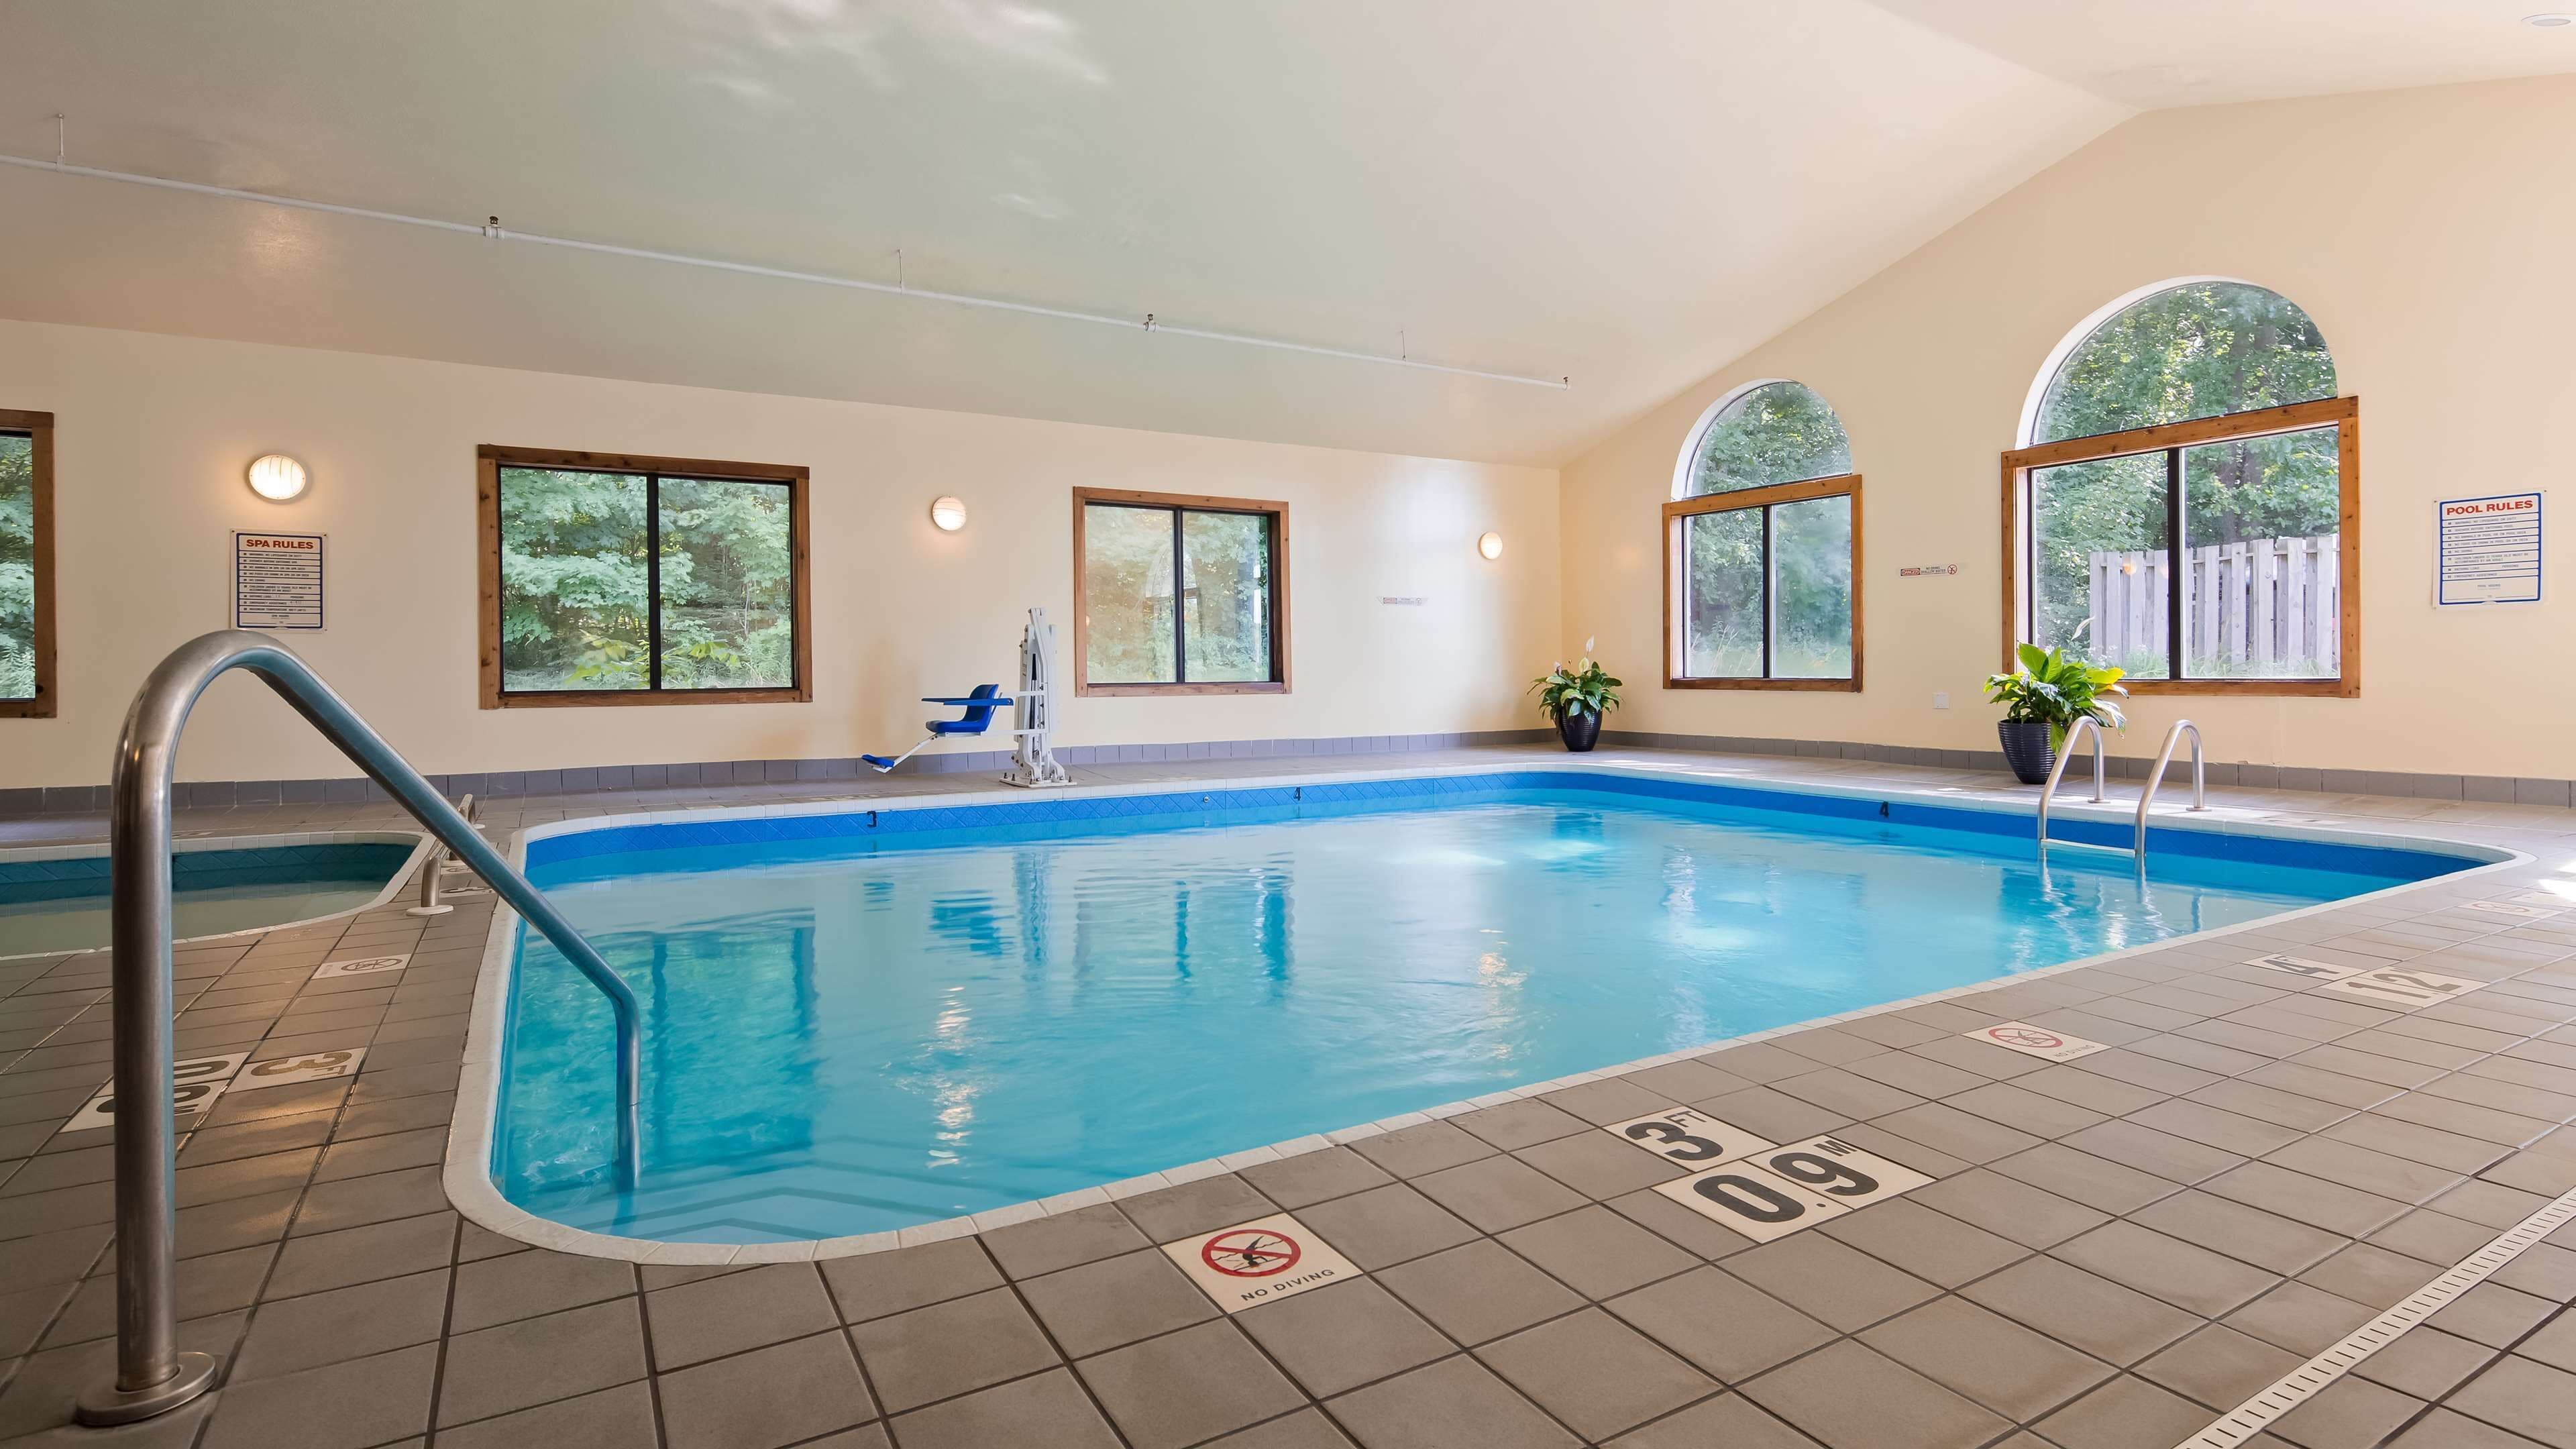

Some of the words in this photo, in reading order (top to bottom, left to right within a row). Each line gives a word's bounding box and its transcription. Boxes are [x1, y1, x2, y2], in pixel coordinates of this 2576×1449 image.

[2447, 505, 2483, 516] POOL
[2486, 500, 2534, 512] RULES
[246, 539, 270, 548] SPA
[272, 540, 314, 549] RULES
[1293, 787, 1301, 801] 4
[2262, 959, 2341, 975] 4
[251, 1051, 352, 1077] 3
[311, 1065, 347, 1077] FT
[1663, 1110, 1707, 1128] FT
[1624, 1121, 1724, 1161] 3
[1693, 1152, 1880, 1224] 0.9
[1813, 1140, 1858, 1157] M
[1240, 1288, 1268, 1301] NO
[1273, 1269, 1336, 1292] DIVING
